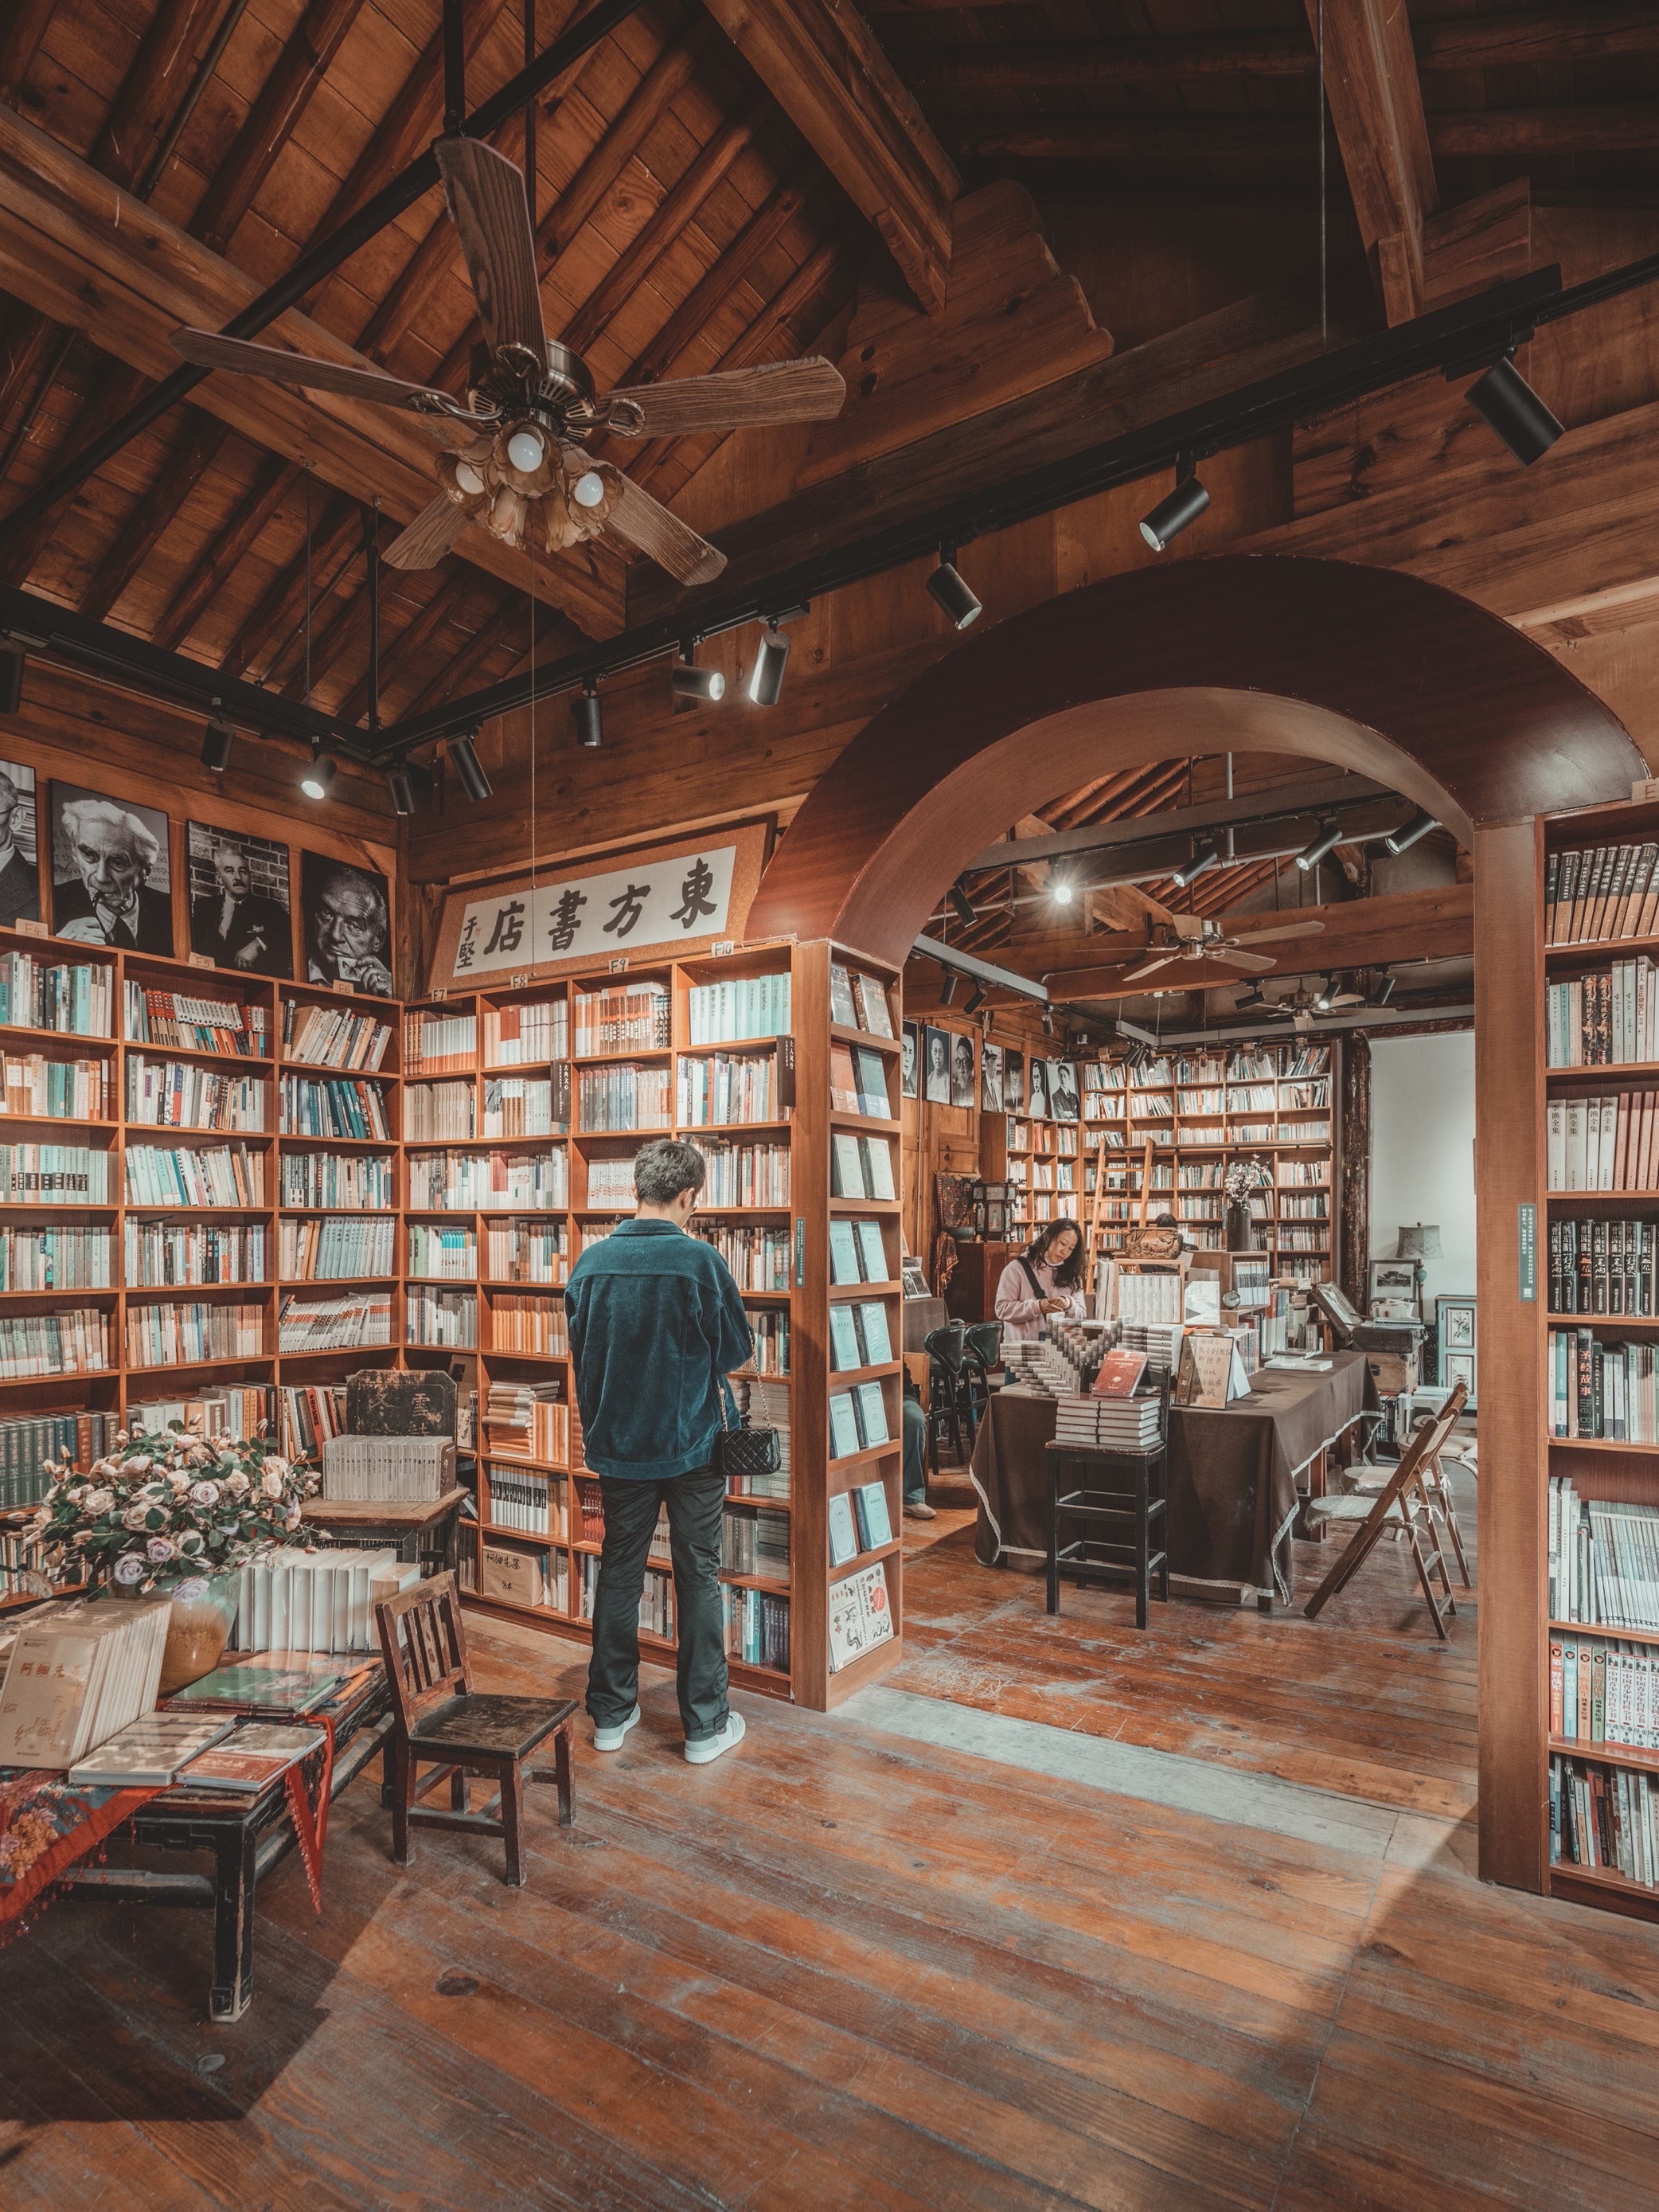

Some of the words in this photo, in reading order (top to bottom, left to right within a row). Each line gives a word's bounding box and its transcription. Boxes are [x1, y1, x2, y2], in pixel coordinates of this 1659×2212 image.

[483, 857, 718, 955] 東方書店
[25, 923, 41, 936] F4
[714, 943, 732, 956] F10
[196, 958, 210, 968] F5
[611, 959, 627, 973] F9
[512, 975, 526, 989] F8
[338, 984, 350, 995] F6
[432, 988, 446, 1000] F7
[1552, 1104, 1560, 1135] 李渔全集
[1569, 1104, 1579, 1135] 李渔全集
[1603, 1102, 1613, 1132] 李渔全集
[1579, 1350, 1592, 1396] 圣经故事
[486, 1553, 521, 1570] 阿细先基
[502, 1580, 513, 1591] 8本
